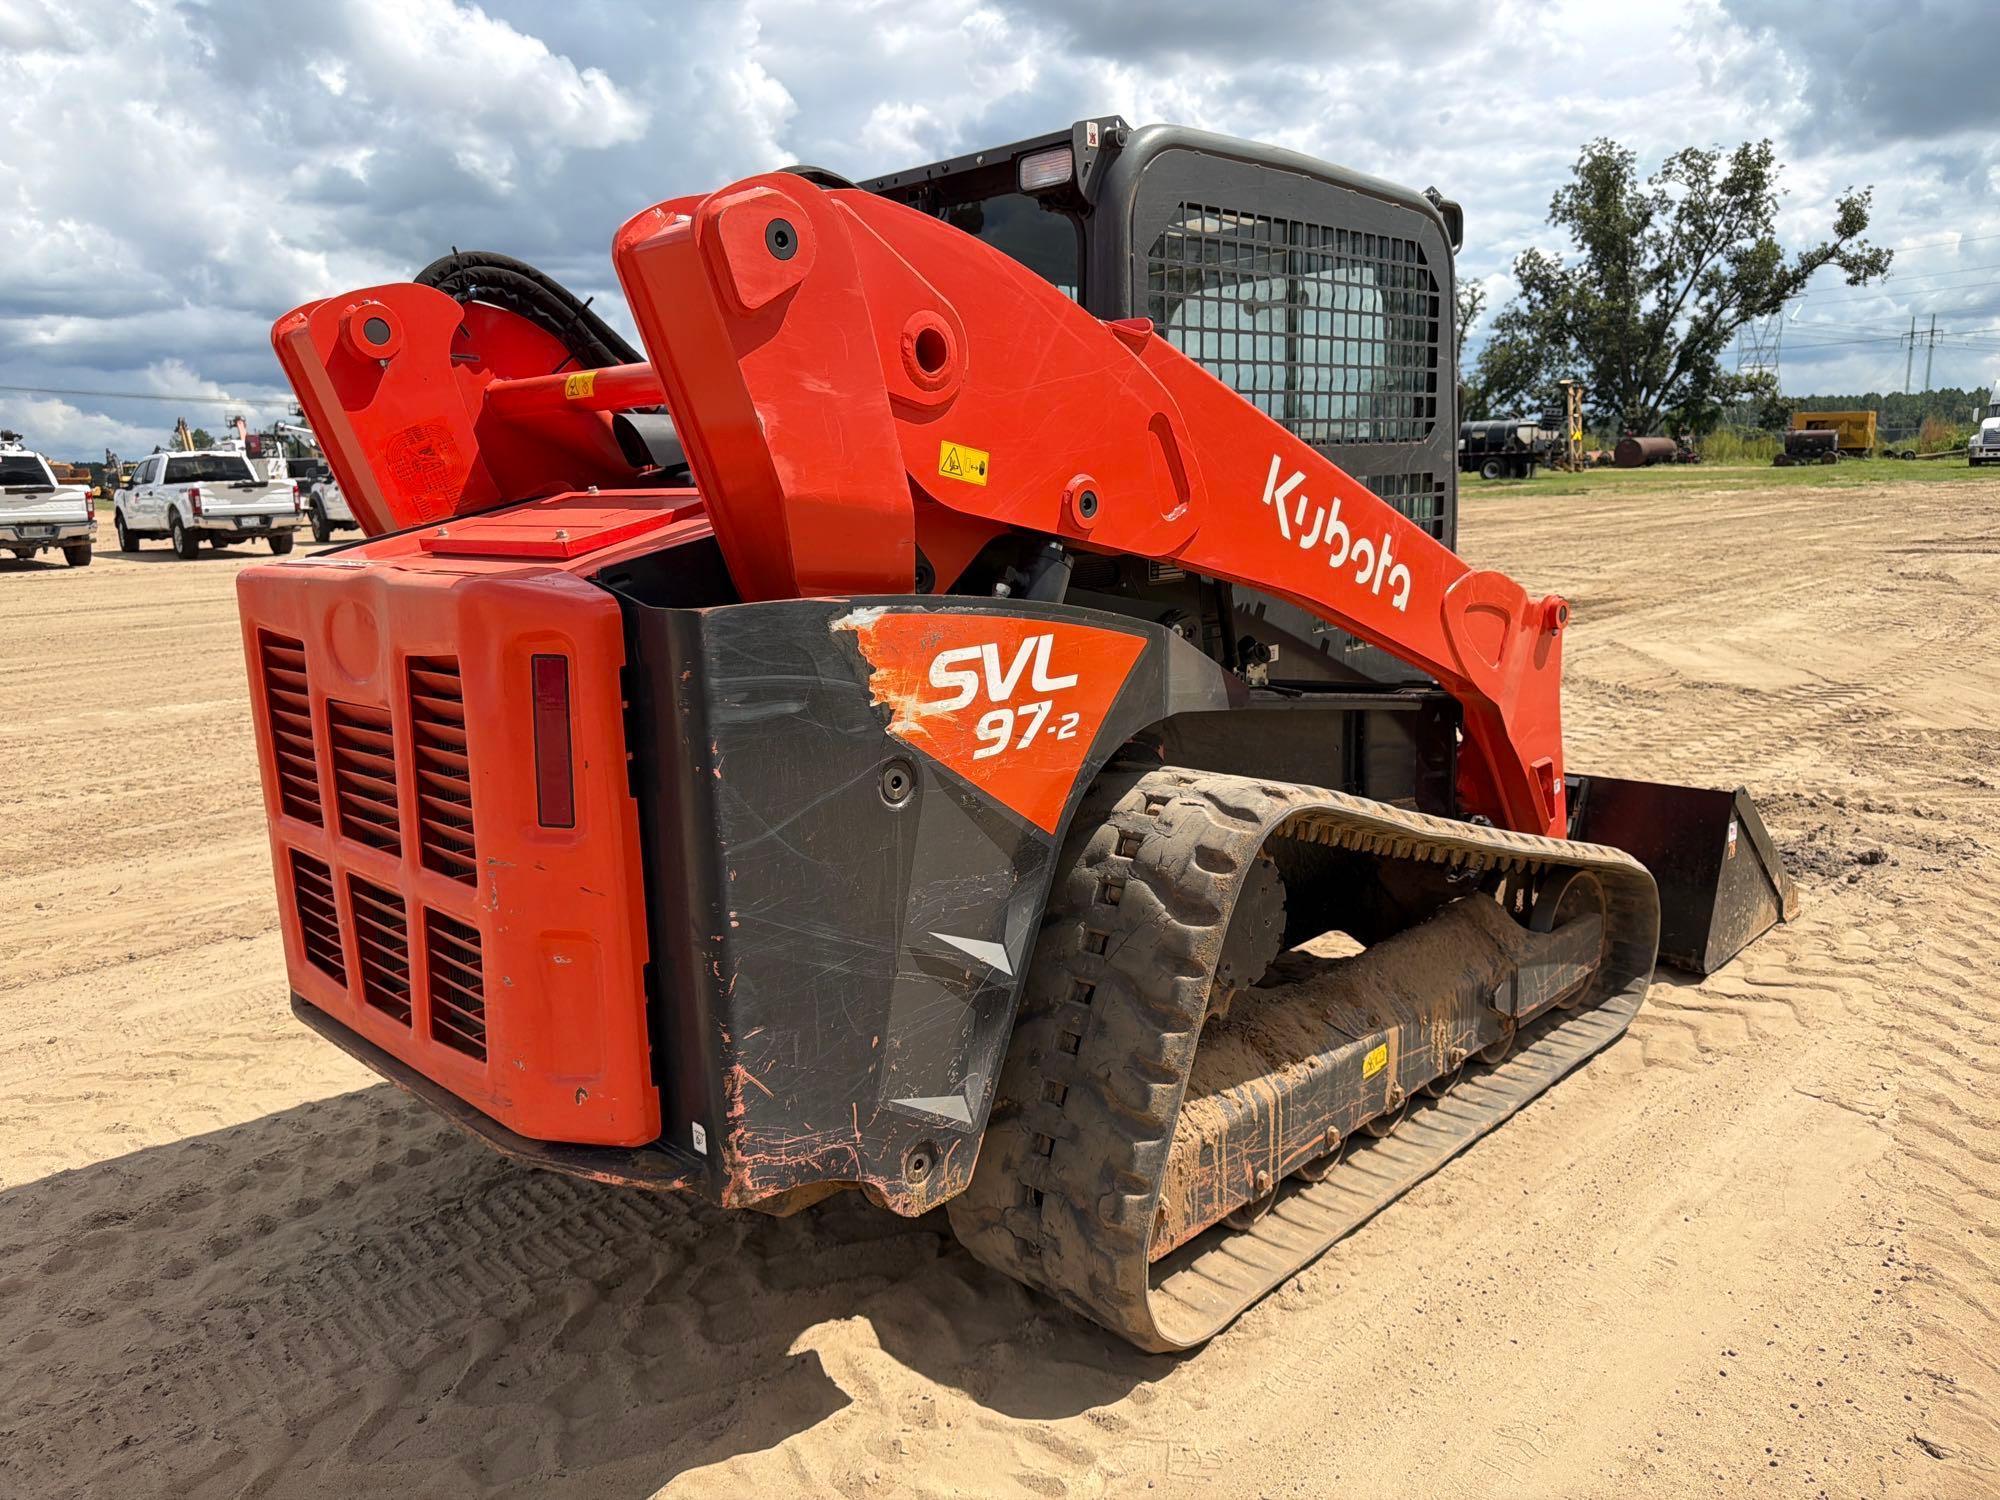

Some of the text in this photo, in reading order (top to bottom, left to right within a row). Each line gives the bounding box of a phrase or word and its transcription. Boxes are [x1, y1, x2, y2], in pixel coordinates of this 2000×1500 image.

[1262, 453, 1412, 613] Kubota
[920, 633, 1079, 717] SVL
[972, 699, 1080, 761] 97-2
